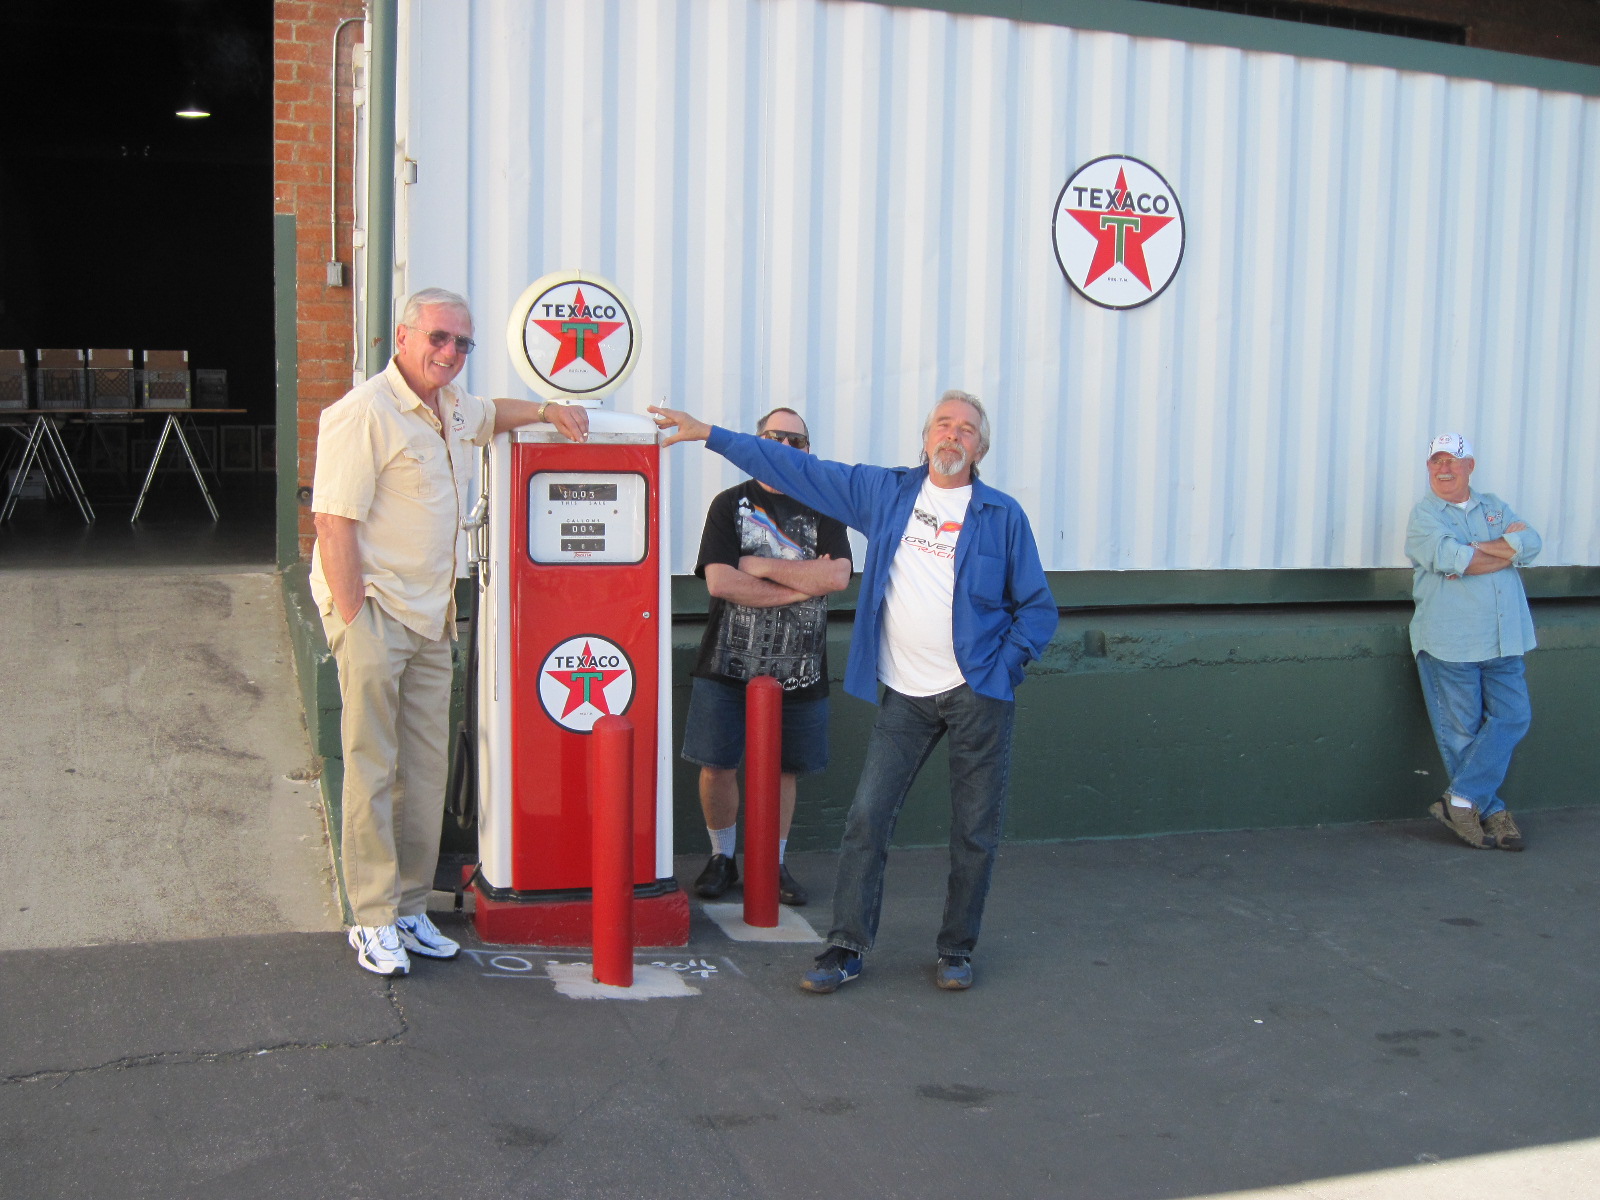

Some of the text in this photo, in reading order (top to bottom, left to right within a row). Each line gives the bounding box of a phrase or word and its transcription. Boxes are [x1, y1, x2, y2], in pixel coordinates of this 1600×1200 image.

[1072, 185, 1170, 215] TEXACO
[1100, 215, 1141, 265] T
[541, 304, 616, 319] TEXACO
[561, 321, 599, 359] T
[554, 656, 620, 668] TEXACO
[571, 671, 604, 703] T
